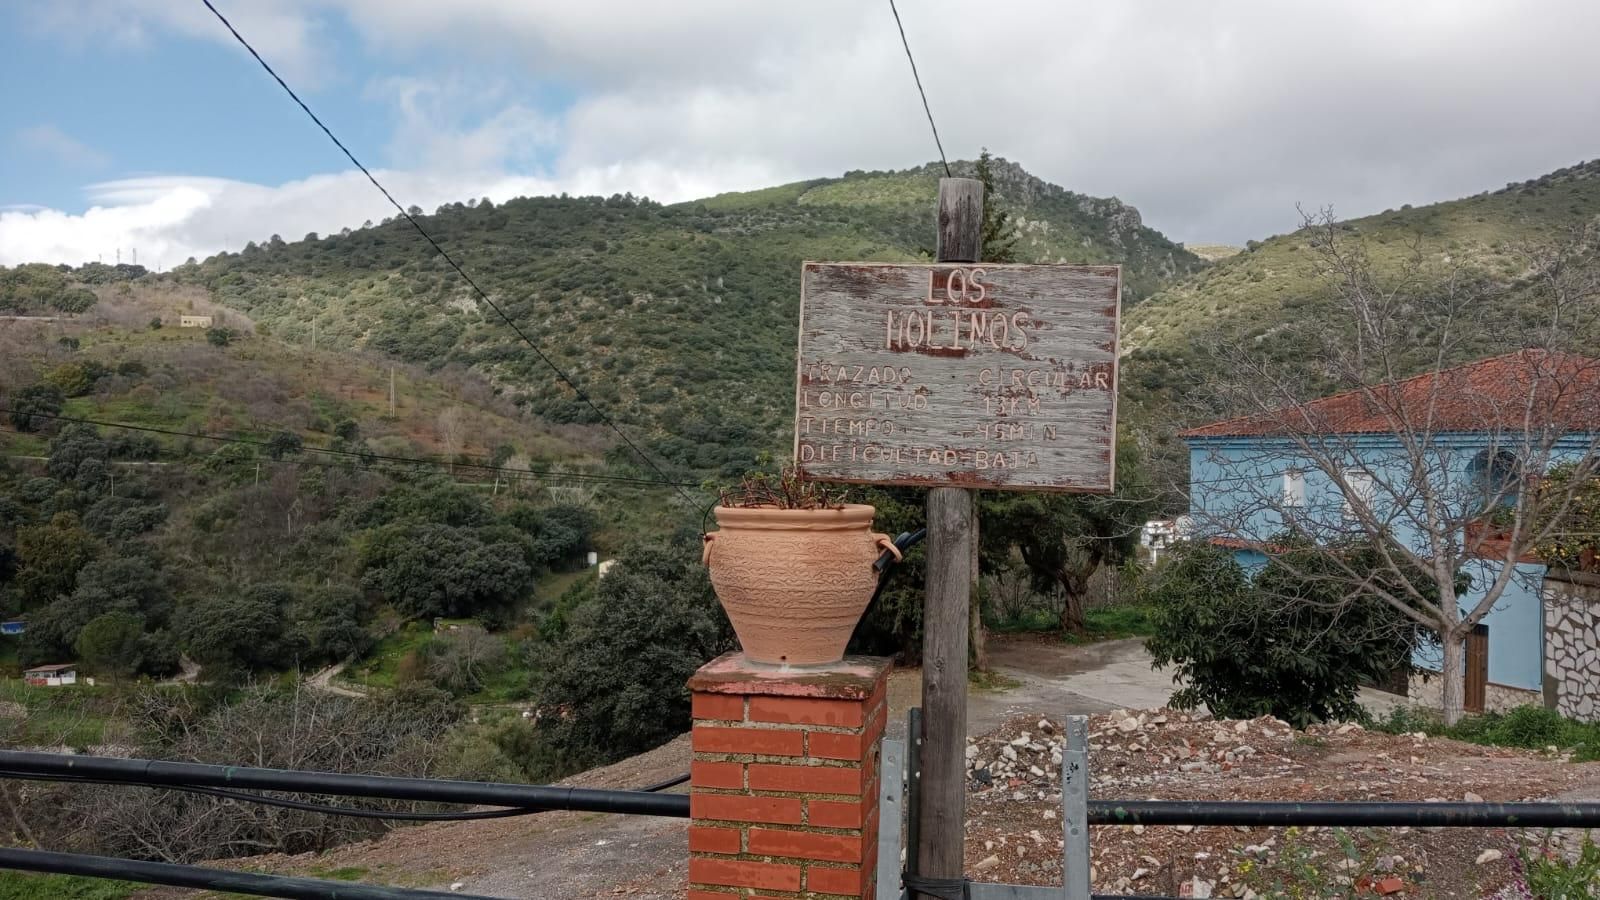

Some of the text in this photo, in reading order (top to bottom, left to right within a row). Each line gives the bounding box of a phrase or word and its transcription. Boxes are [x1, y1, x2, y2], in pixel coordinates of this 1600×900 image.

[925, 268, 986, 303] LOS
[806, 363, 911, 383] TRAZADO
[979, 368, 1108, 389] CIRCULAR
[804, 391, 927, 411] LONGITUD
[802, 416, 894, 437] TIEMPO
